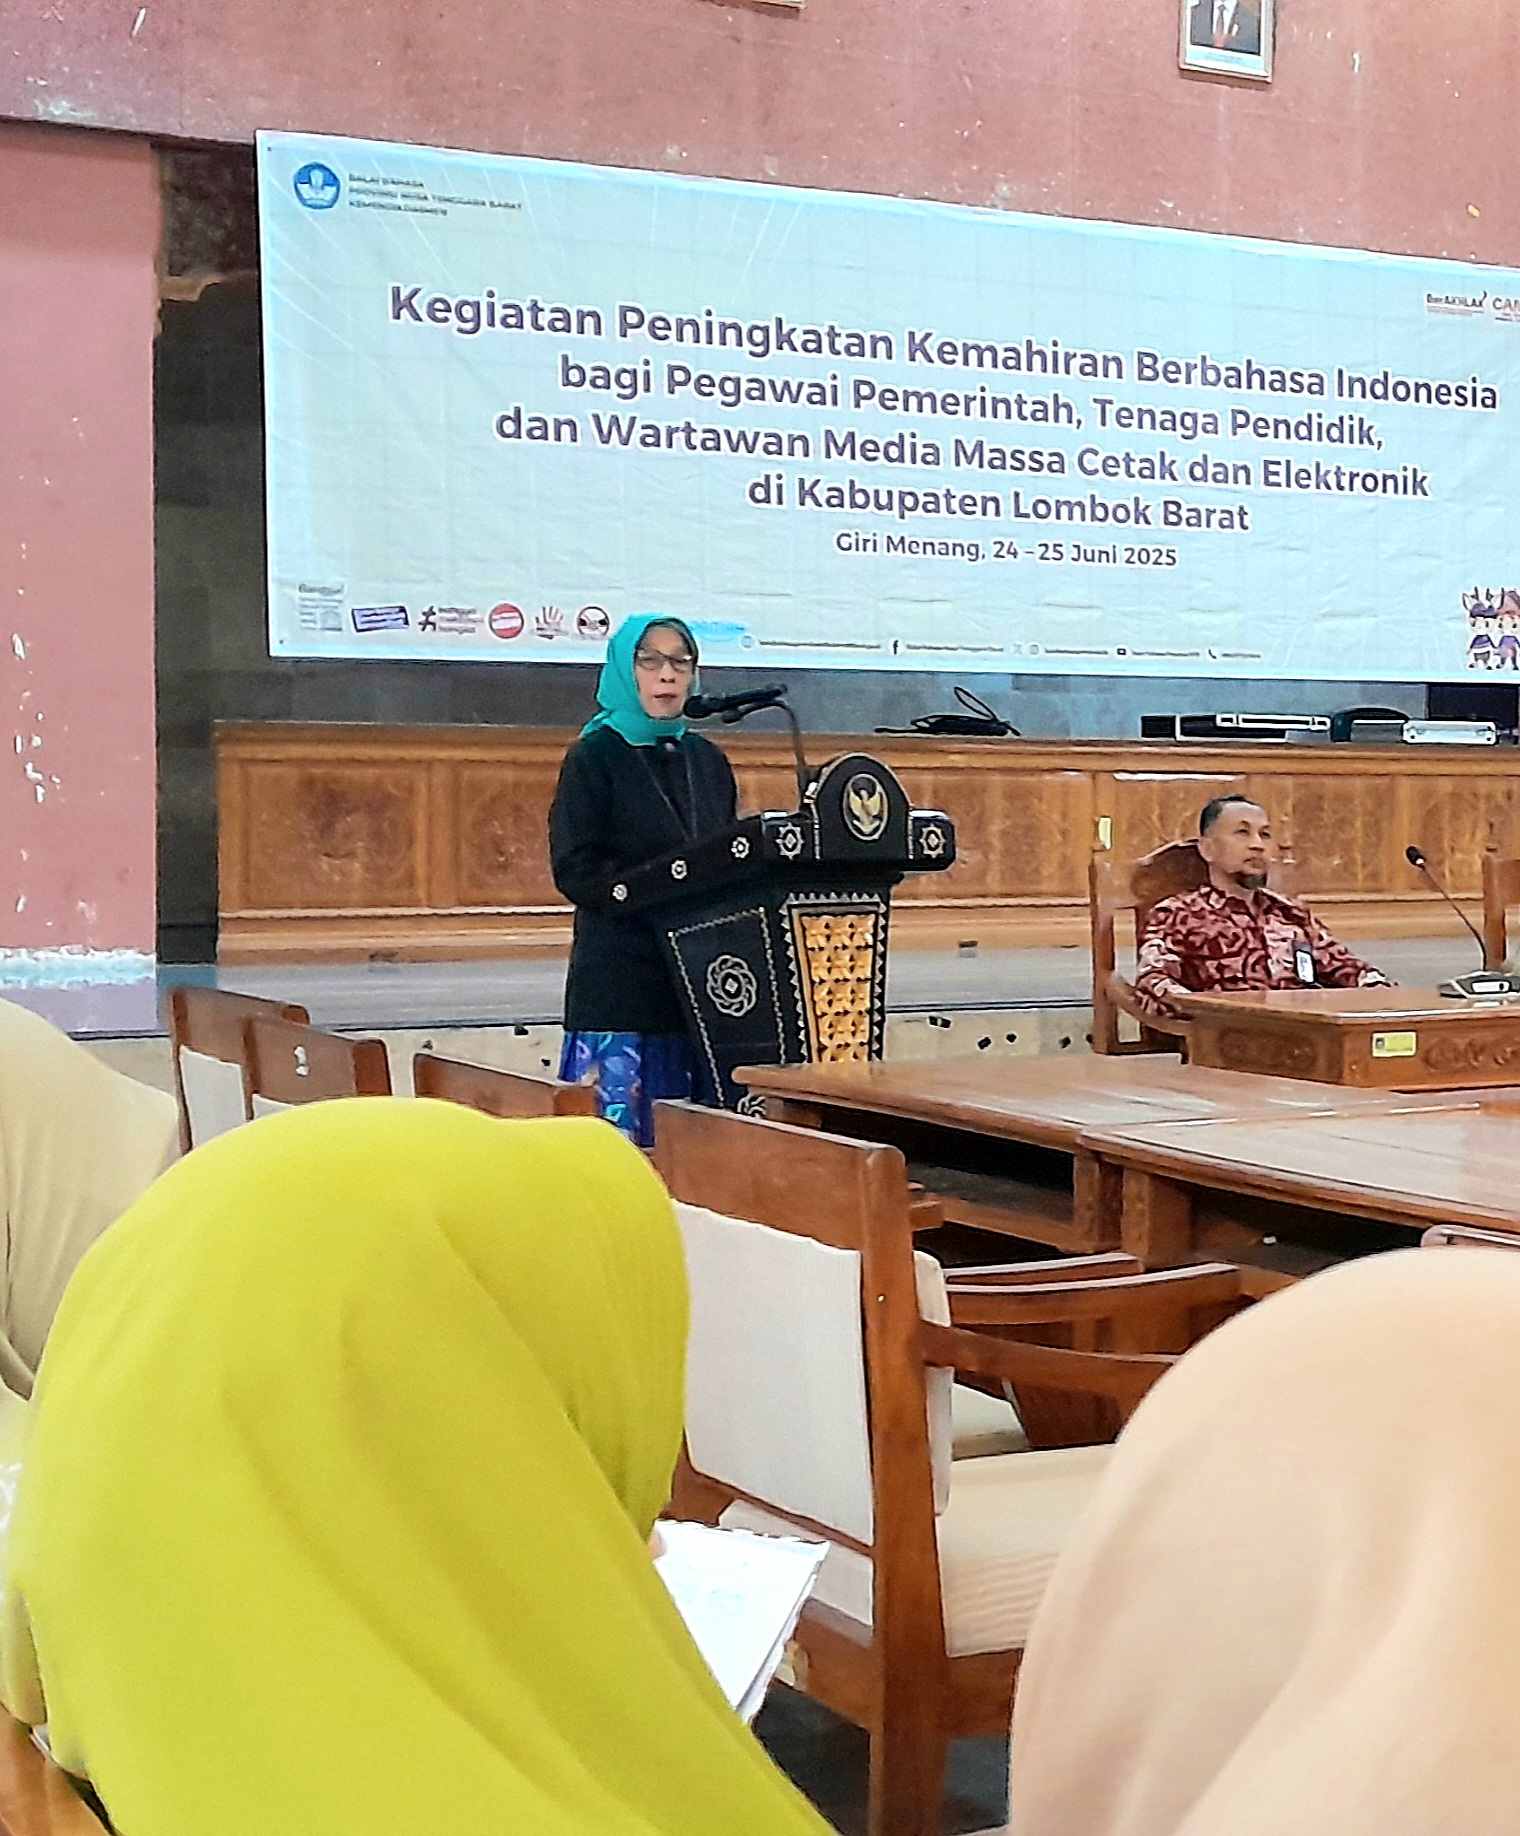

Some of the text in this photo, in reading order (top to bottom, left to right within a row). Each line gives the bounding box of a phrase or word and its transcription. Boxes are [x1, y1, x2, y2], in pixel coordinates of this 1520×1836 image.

[391, 286, 1498, 409] Kegiatan Peningkatan Kemahiran Berbahasa Indonesia
[561, 354, 1383, 451] bagi Pegawai Pemerintah, Tenaga Pendidik,
[495, 406, 1430, 498] dan Wartawan Media Massa Cetak dan Elektronik
[749, 474, 1250, 531] di Kabupaten Lombok Barat
[836, 532, 878, 553] Giri
[886, 535, 986, 561] Menang,
[992, 541, 1018, 559] 24
[1038, 543, 1064, 561] 25
[1071, 544, 1118, 564] Juni
[1124, 547, 1177, 566] 2025
